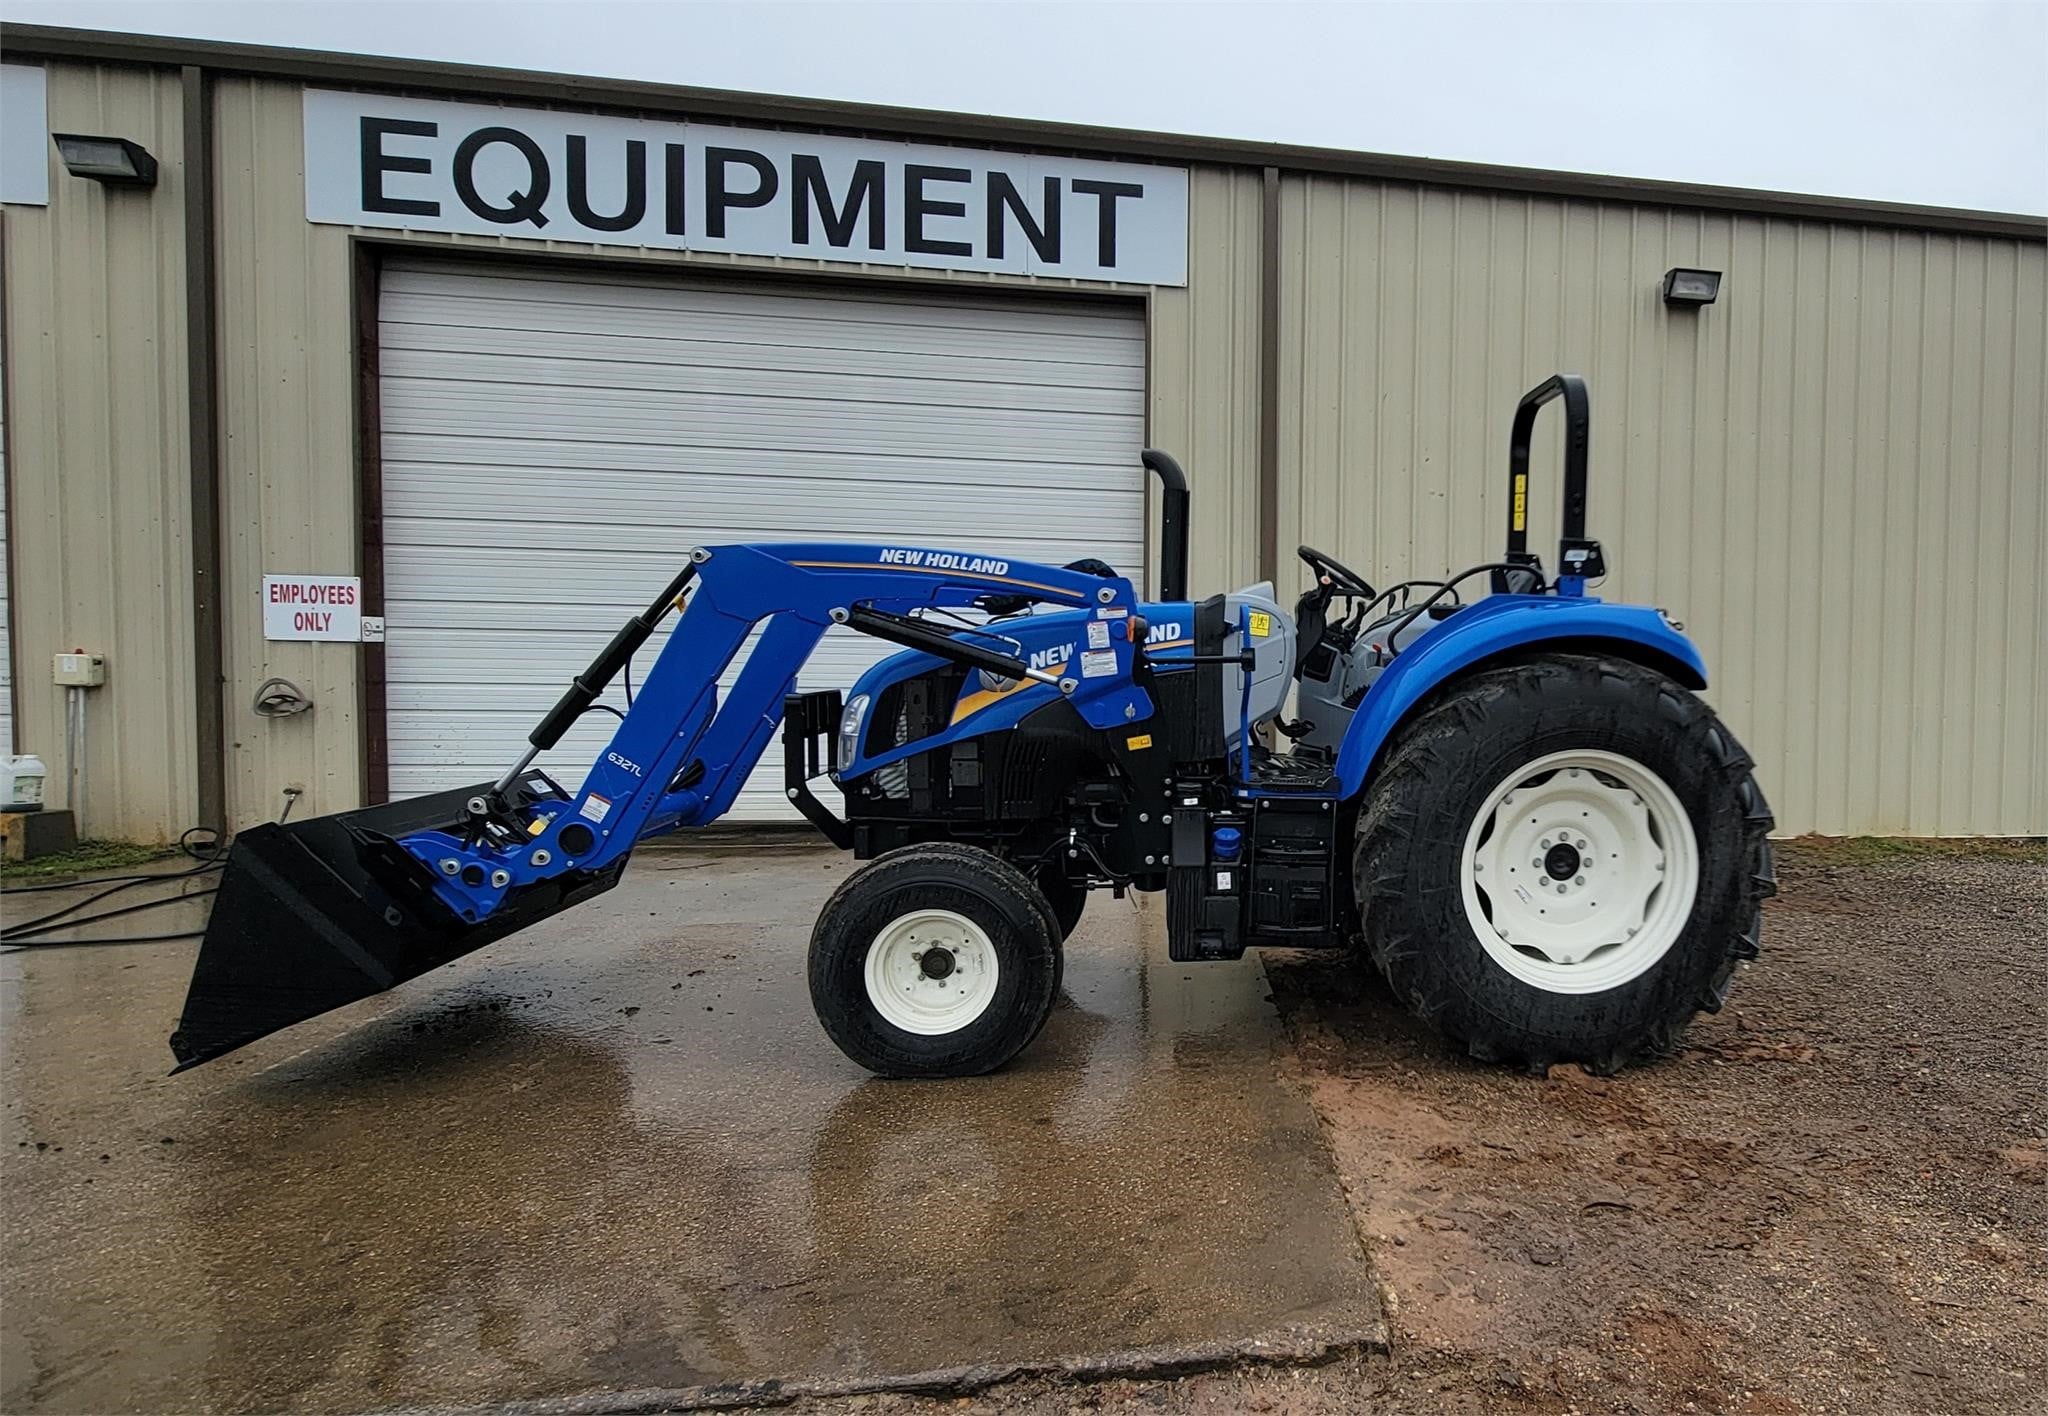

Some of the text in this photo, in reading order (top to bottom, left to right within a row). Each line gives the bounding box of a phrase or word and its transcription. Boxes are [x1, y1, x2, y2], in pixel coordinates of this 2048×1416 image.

[359, 115, 1145, 269] EQUIPMENT
[879, 548, 1009, 576] NEW HOLLAND
[270, 583, 355, 605] EMPLOYEES
[294, 612, 332, 632] ONLY
[607, 751, 642, 778] 632TL
